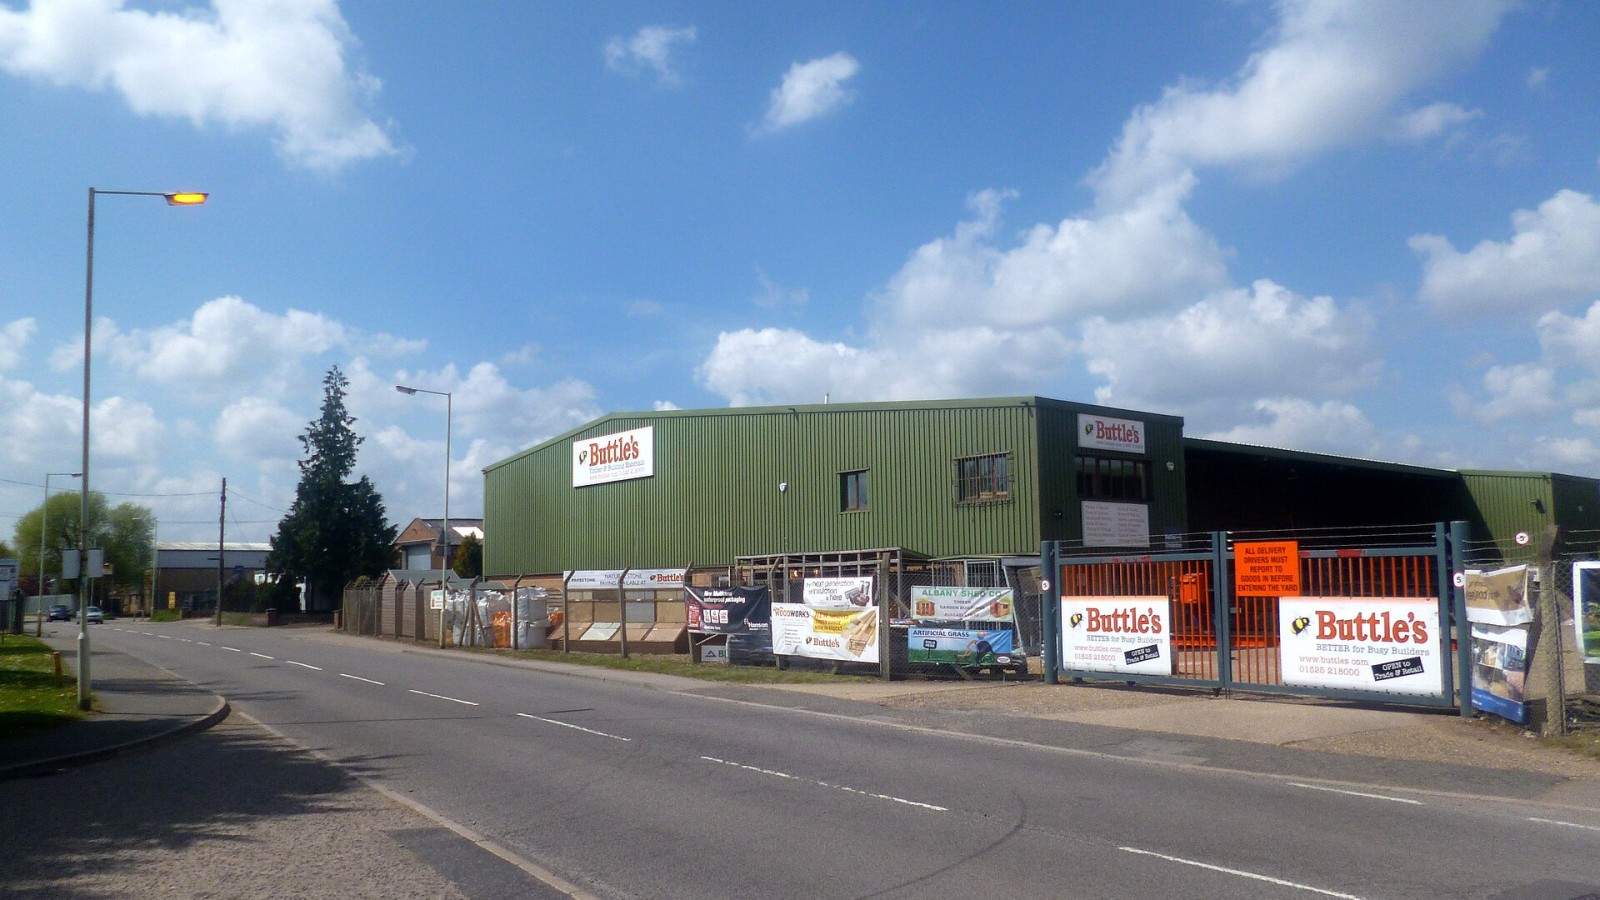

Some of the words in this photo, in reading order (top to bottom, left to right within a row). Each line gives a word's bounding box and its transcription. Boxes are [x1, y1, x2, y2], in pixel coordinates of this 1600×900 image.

[1095, 421, 1140, 443] Buttle's
[589, 435, 639, 467] Buttle's
[1244, 556, 1269, 564] DRIVERS
[657, 574, 684, 582] Buttle's
[922, 589, 959, 597] ALBANY
[1086, 607, 1162, 634] Buttle's
[1315, 610, 1428, 644] Buttle's
[948, 630, 970, 638] GRASS
[813, 637, 840, 648] Buttle's
[1121, 636, 1136, 644] Busy
[1137, 636, 1163, 644] Builders
[1074, 644, 1122, 652] www.buttles.com
[1316, 643, 1351, 653] BETTER
[1352, 645, 1365, 653] for
[1367, 646, 1388, 656] Busy
[1391, 647, 1430, 656] Builders
[1127, 656, 1139, 664] Trade
[1144, 652, 1158, 660] Retail
[1299, 656, 1369, 666] www.buttles.com
[1299, 666, 1325, 674] 01525
[1327, 667, 1360, 676] 218000
[1382, 662, 1401, 671] OPEN
[1375, 671, 1394, 680] Trade
[1395, 669, 1401, 677] &
[1402, 665, 1423, 676] Retail
